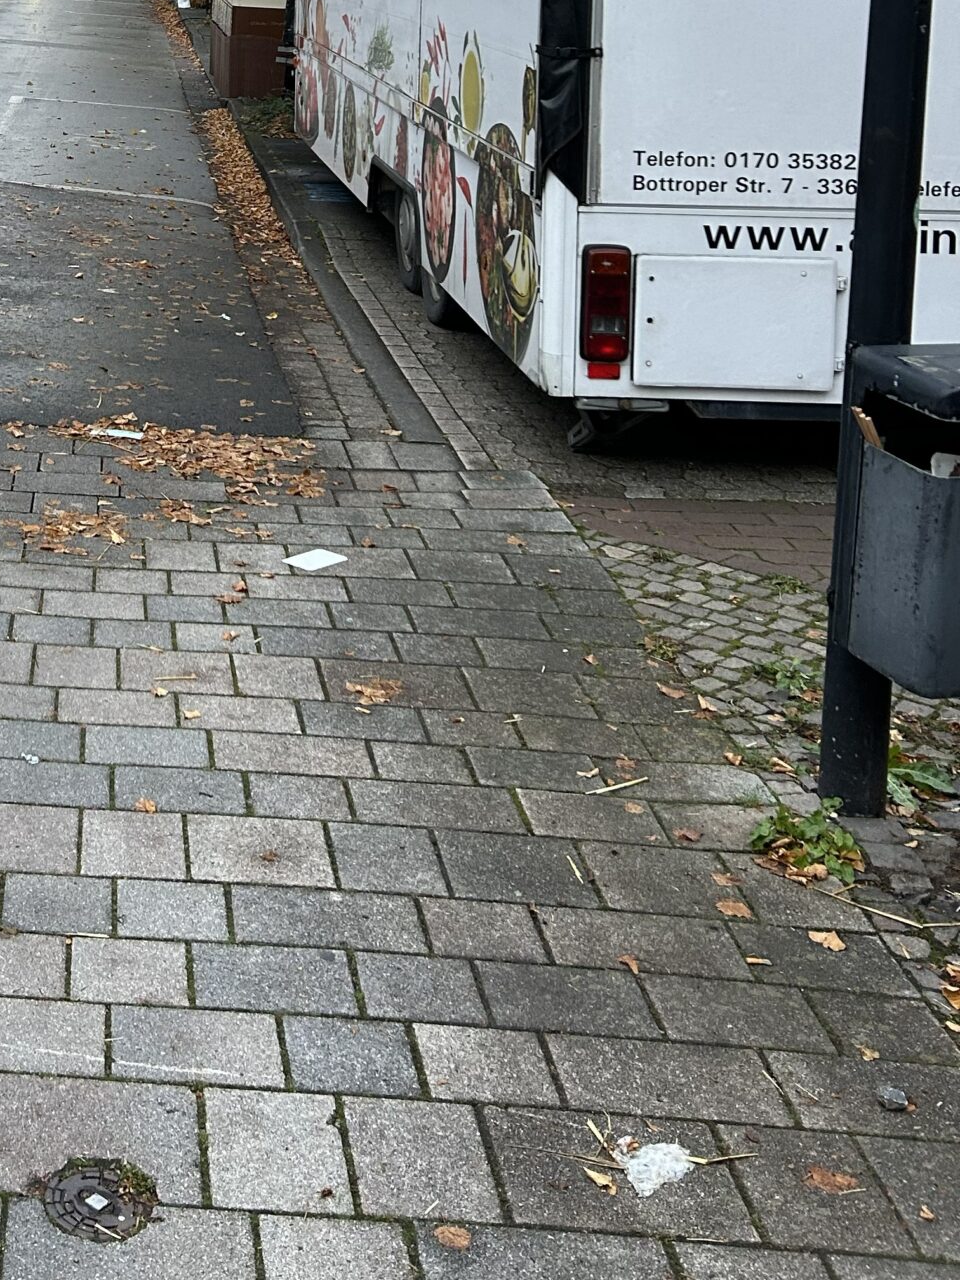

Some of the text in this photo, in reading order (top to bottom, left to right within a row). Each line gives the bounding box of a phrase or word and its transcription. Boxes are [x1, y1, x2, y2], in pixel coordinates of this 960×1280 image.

[633, 150, 857, 170] Telefon: 0170 35382
[633, 175, 727, 195] Bottroper
[735, 176, 772, 194] Str.
[781, 177, 793, 194] 7
